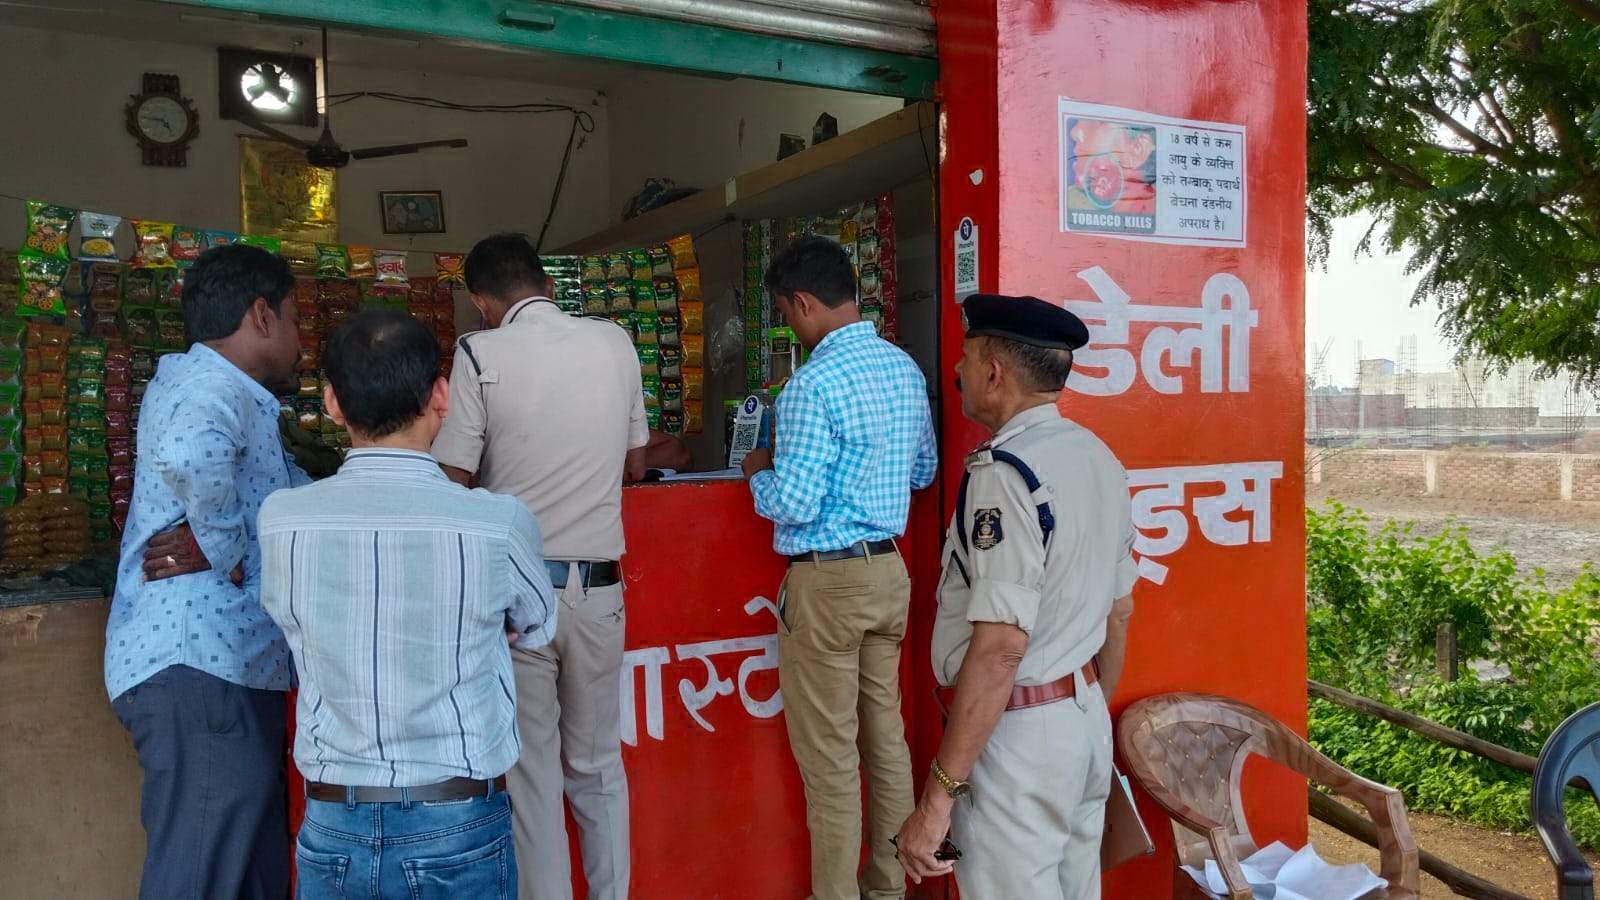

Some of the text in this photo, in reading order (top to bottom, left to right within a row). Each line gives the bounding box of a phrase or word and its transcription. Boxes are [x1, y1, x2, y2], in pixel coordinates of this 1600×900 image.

[1170, 131, 1232, 149] 18 वर्ष से कम
[1169, 152, 1234, 170] आयु के व्यक्ति
[1161, 171, 1240, 192] को तम्बाकू पदार्थ
[1169, 192, 1232, 210] बेचना दंडनीय
[1071, 212, 1152, 229] TOBACCO KILLS
[1179, 217, 1210, 230] अपराध
[1064, 265, 1259, 396] डेली
